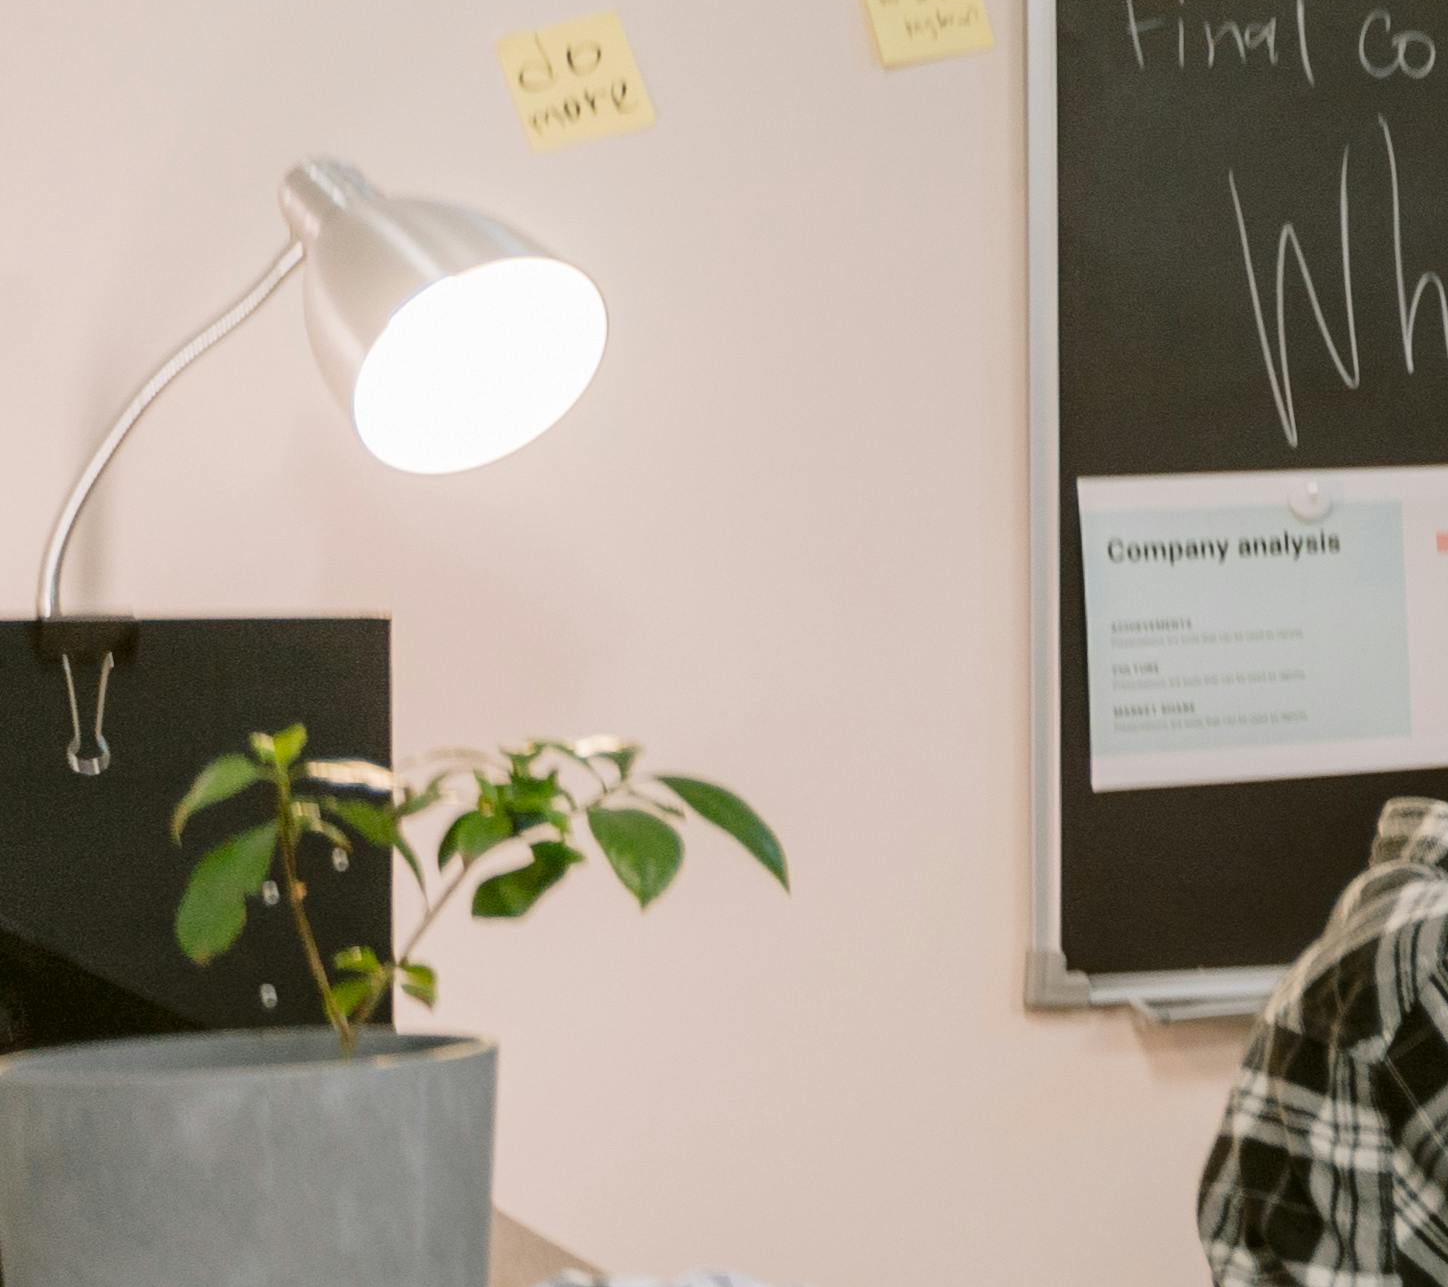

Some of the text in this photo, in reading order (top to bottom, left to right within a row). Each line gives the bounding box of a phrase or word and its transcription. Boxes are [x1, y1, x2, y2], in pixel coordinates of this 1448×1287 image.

[516, 32, 603, 94] do
[1106, 530, 1342, 568] Company analysis
